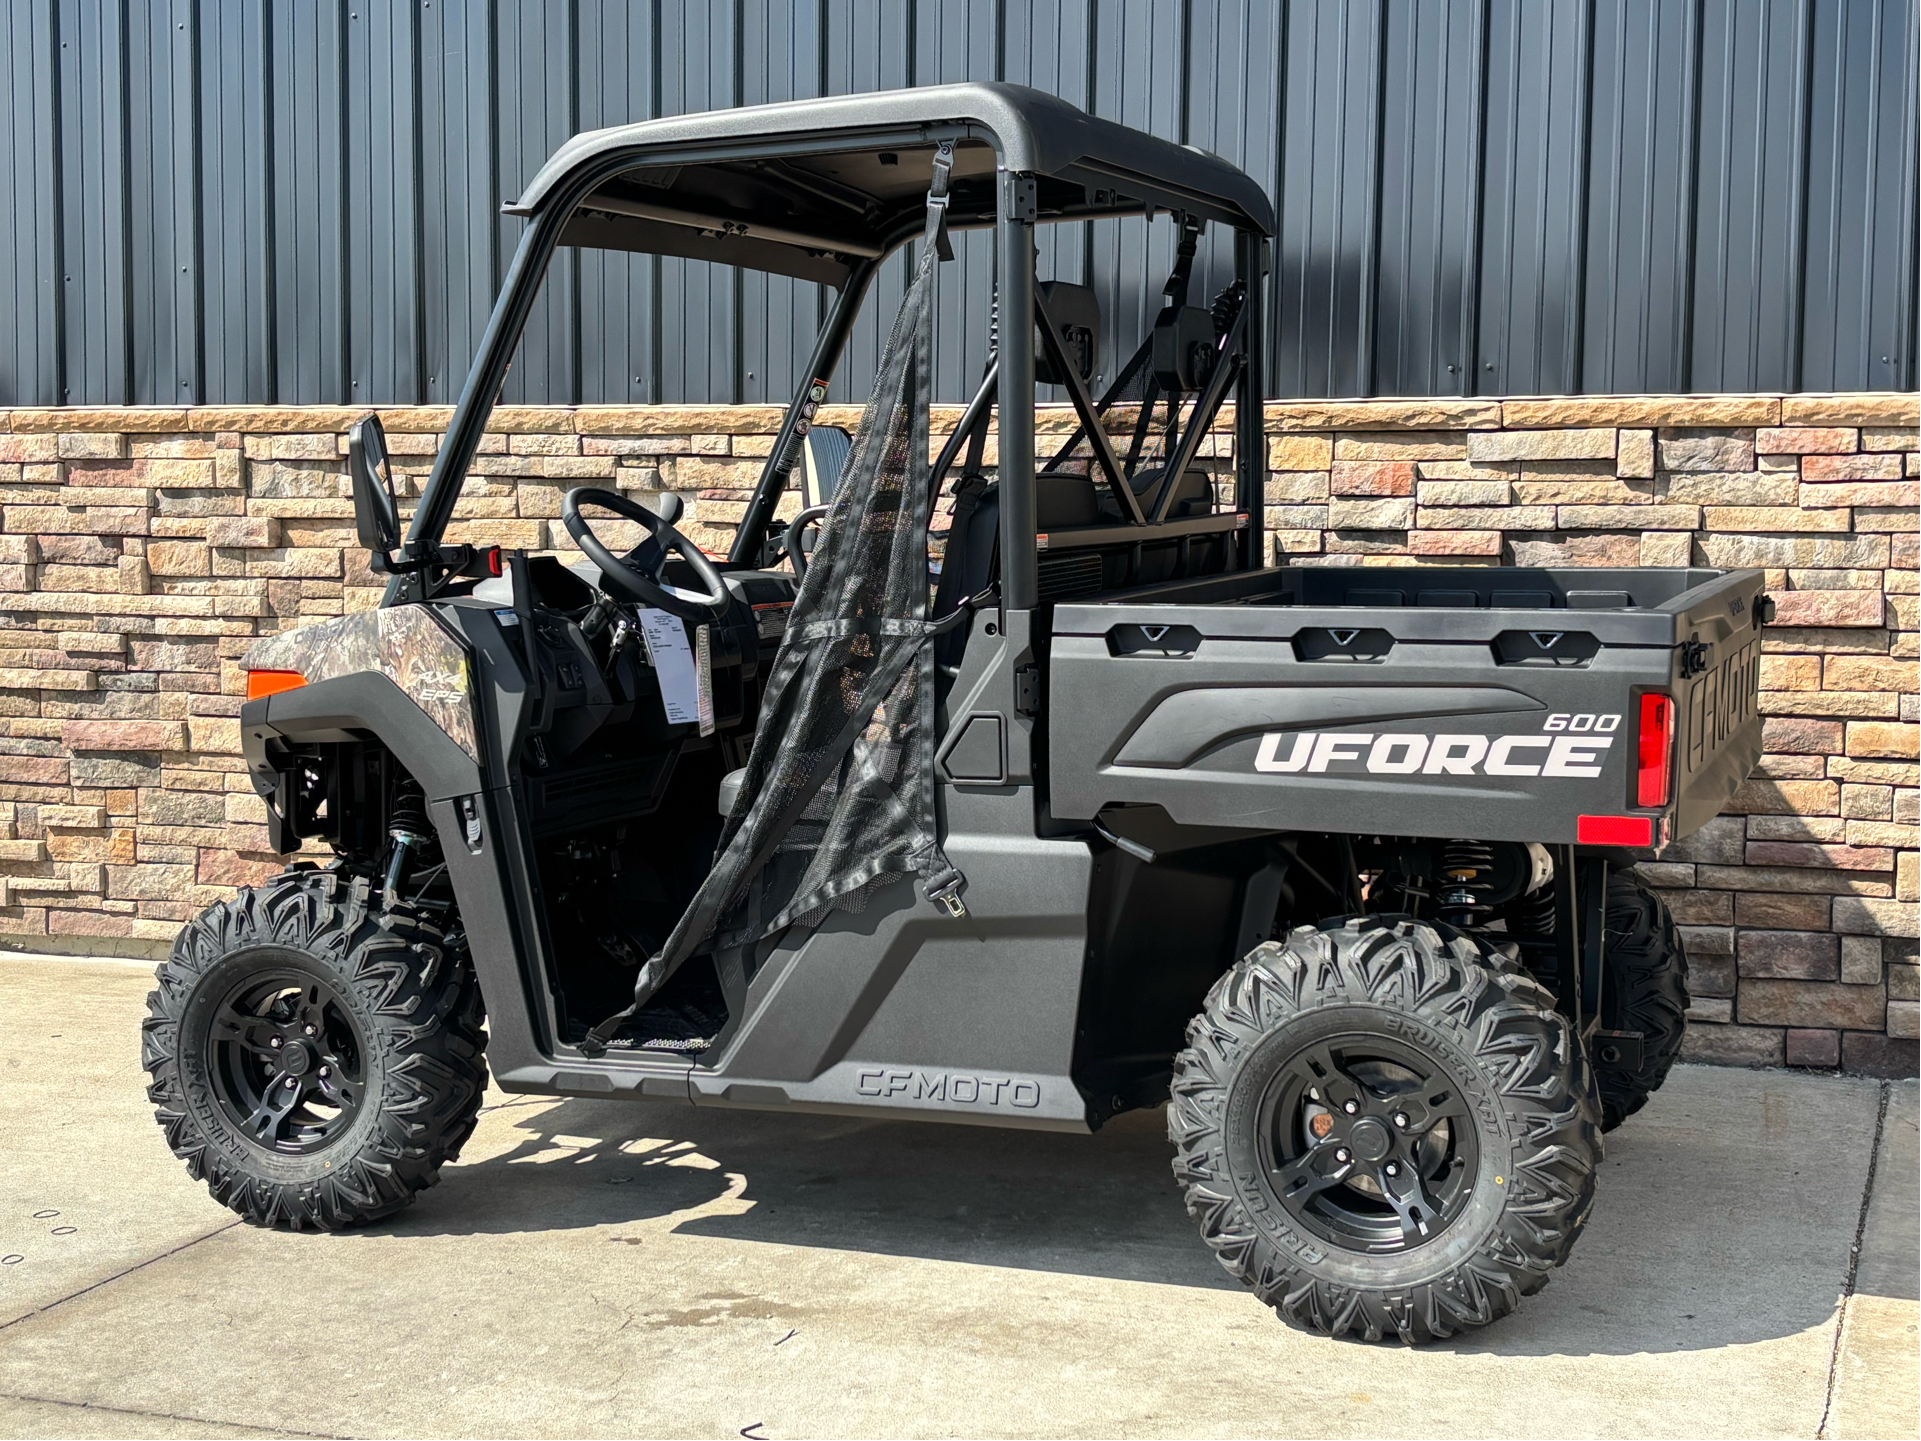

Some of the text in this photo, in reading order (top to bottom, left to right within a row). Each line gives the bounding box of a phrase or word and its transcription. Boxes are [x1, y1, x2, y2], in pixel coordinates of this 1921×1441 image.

[419, 689, 465, 703] EPS
[1543, 713, 1622, 732] 600
[1254, 732, 1614, 778] UFORCE
[1384, 1015, 1477, 1089] BRUISER
[855, 1068, 1041, 1109] CFMOTO
[1239, 1171, 1329, 1265] ARISUN
